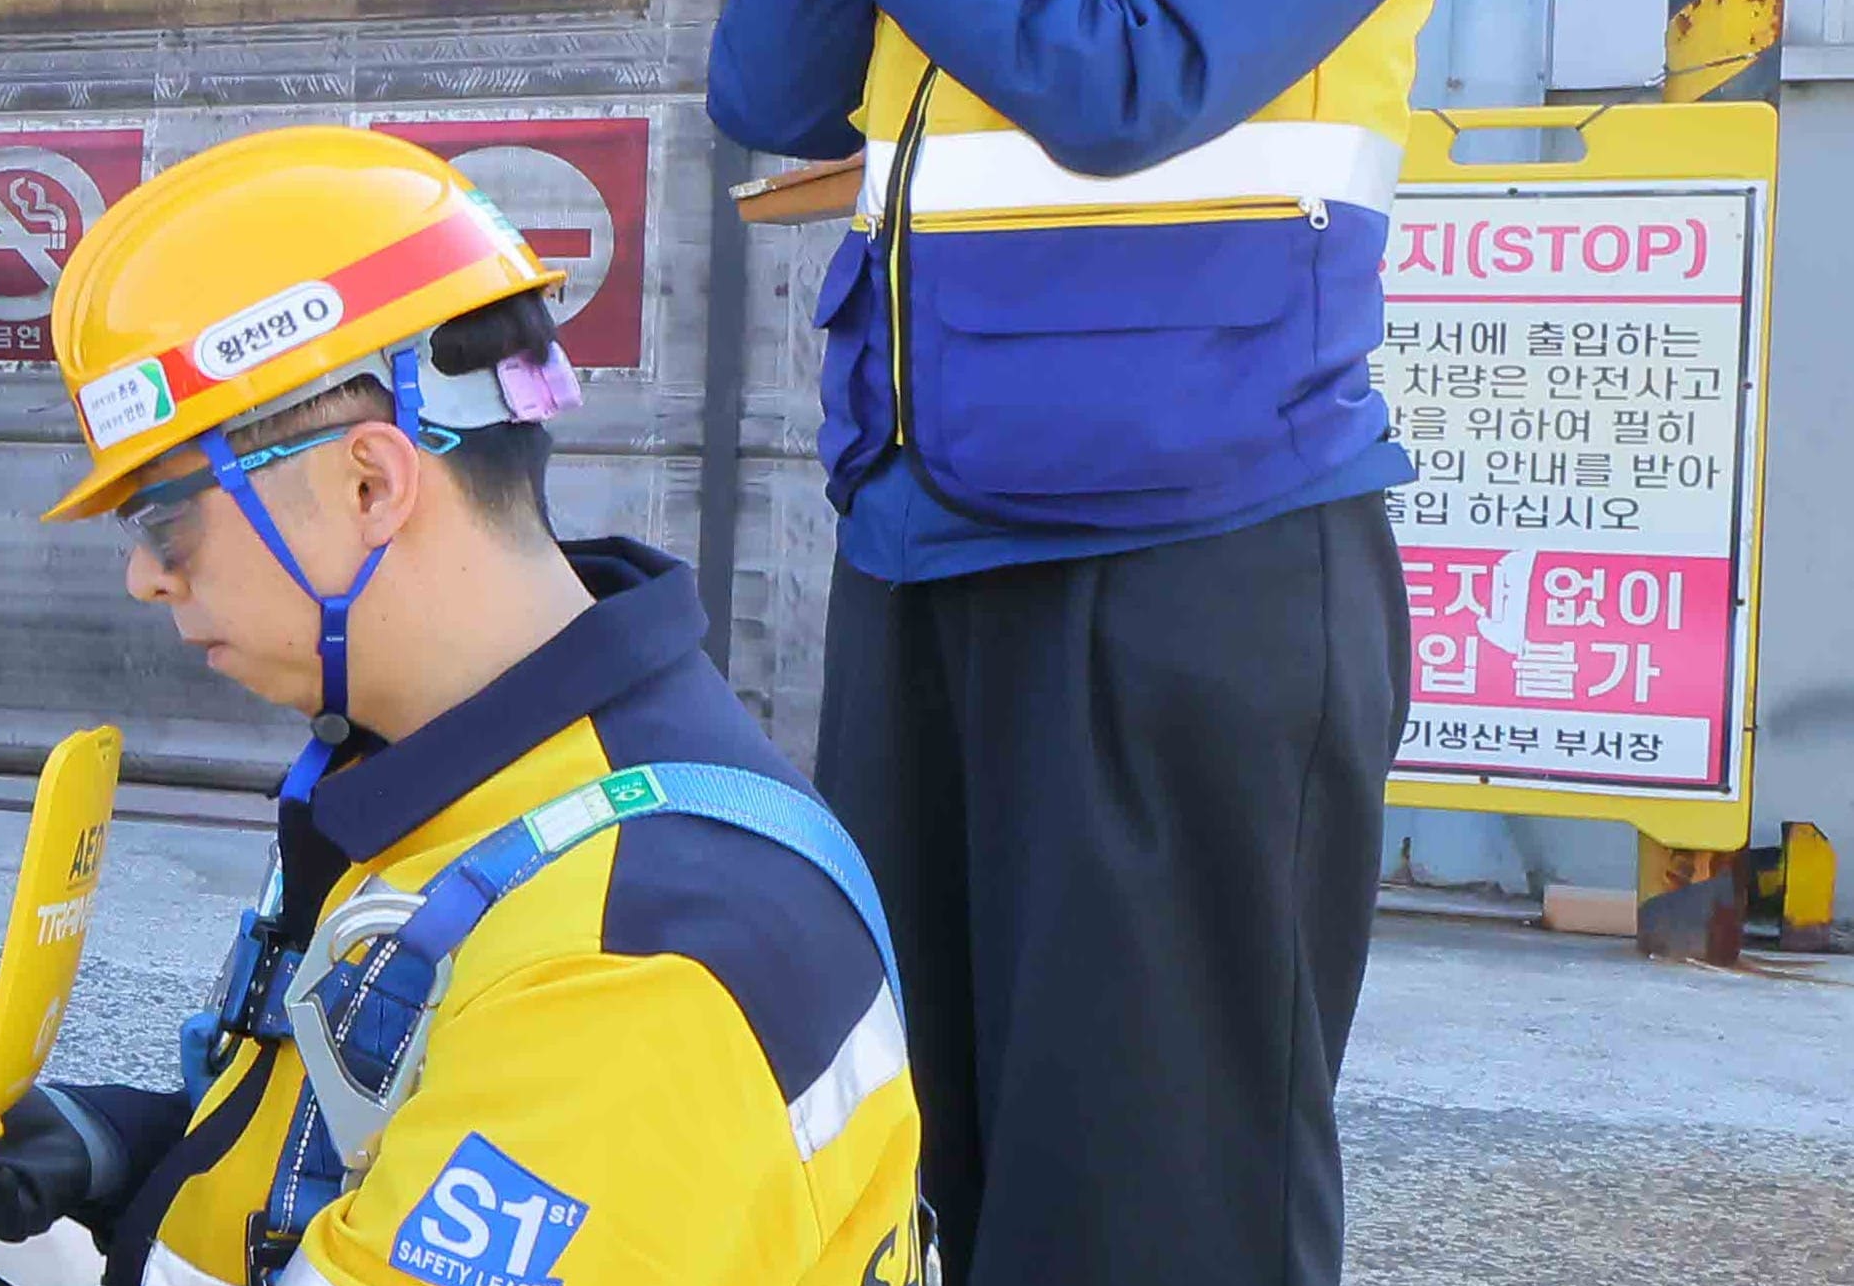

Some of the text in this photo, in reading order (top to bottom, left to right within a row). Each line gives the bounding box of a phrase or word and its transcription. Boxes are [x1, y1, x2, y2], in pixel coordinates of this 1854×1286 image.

[1379, 218, 1708, 279] 지(STOP)
[1385, 321, 1701, 358] 부서에 출입하는
[1404, 363, 1528, 400] 차량은
[1547, 364, 1722, 402] 안전사고
[1466, 407, 1591, 443] 위하여
[1612, 409, 1696, 446] 필히
[1486, 450, 1612, 488] 안내를
[1633, 453, 1721, 490] 받아
[1468, 492, 1640, 531] 하십시오
[1544, 566, 1683, 630] 없이
[1512, 640, 1661, 703] 불가
[1554, 729, 1663, 762] 부서장
[398, 1240, 472, 1286] SAFETY
